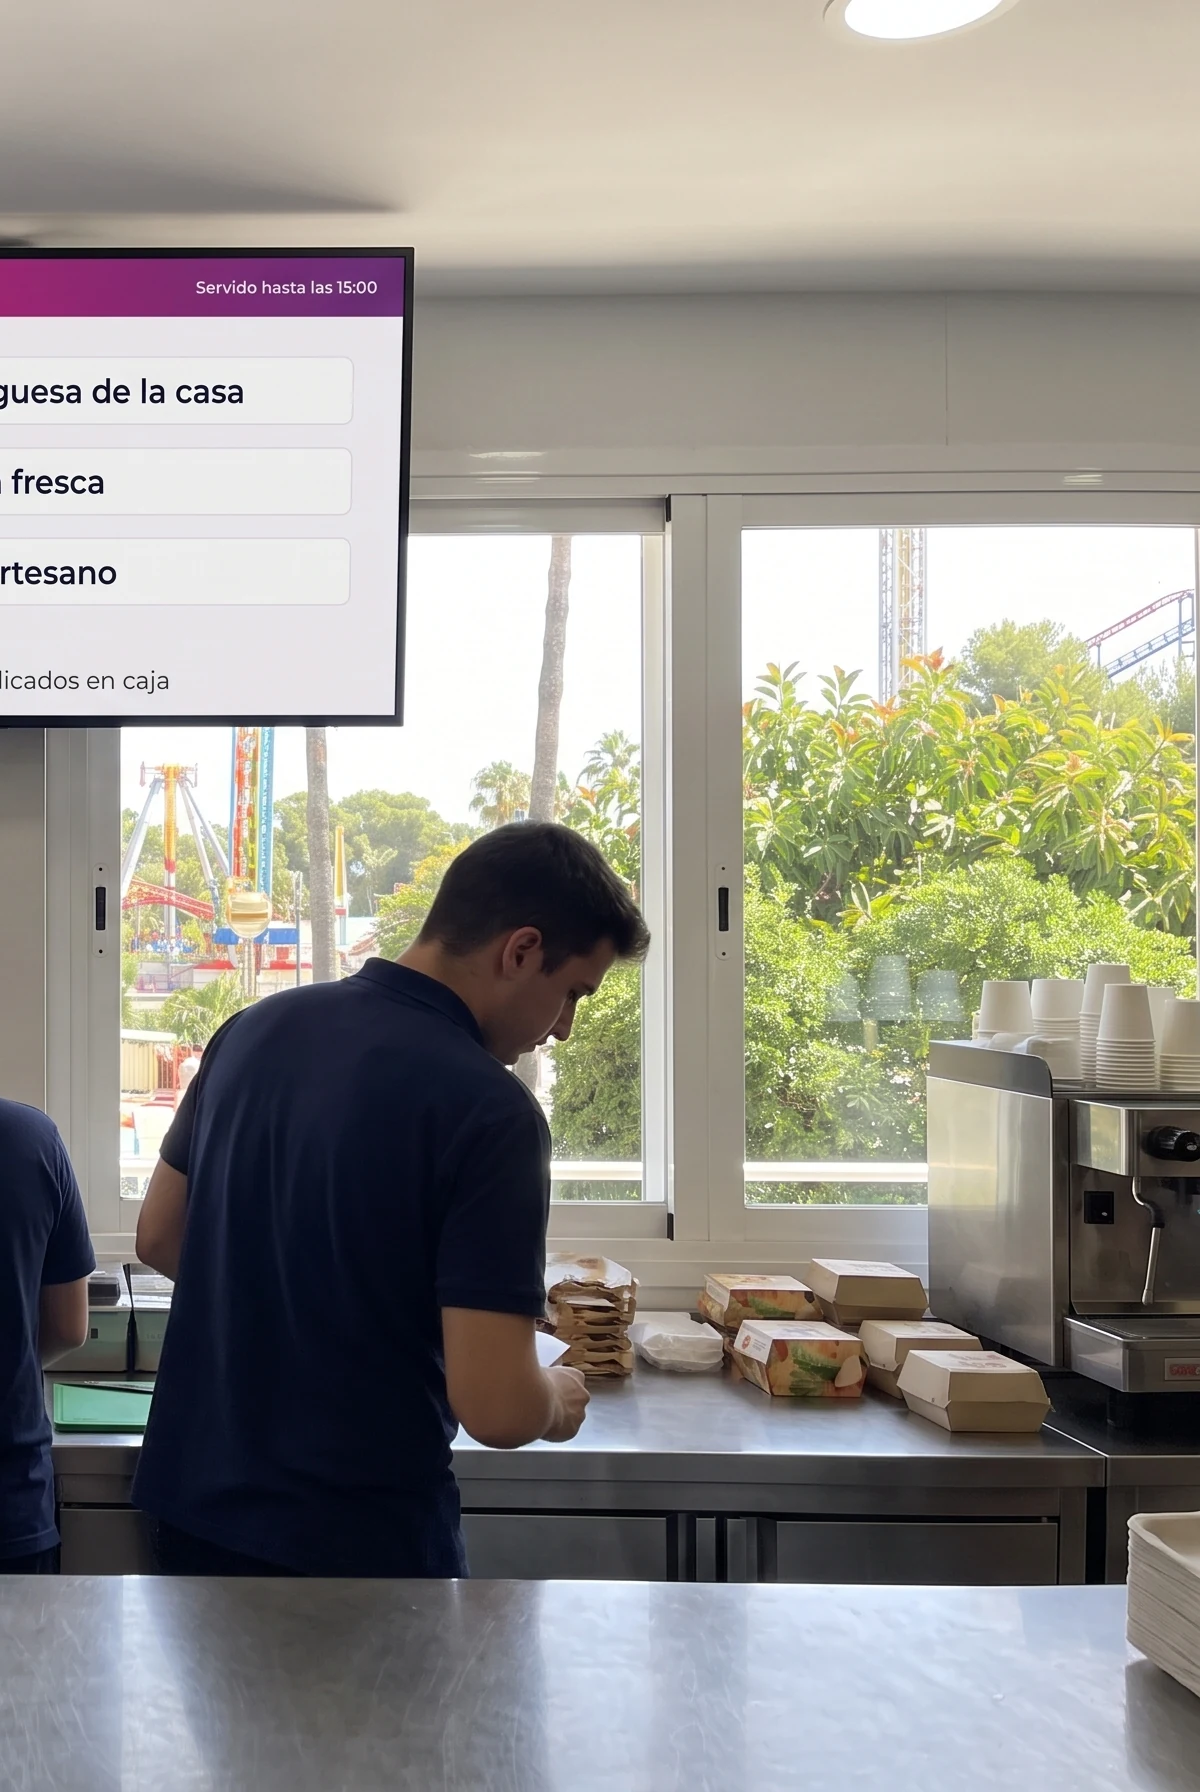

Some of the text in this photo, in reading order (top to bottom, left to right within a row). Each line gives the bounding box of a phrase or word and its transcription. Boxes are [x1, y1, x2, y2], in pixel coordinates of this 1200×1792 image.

[195, 280, 378, 295] Servido hasta las 15:00
[92, 378, 130, 404] de
[142, 378, 165, 404] la
[176, 384, 243, 404] casa
[11, 468, 104, 494] fresca
[87, 676, 114, 689] en
[123, 670, 168, 694] caja
